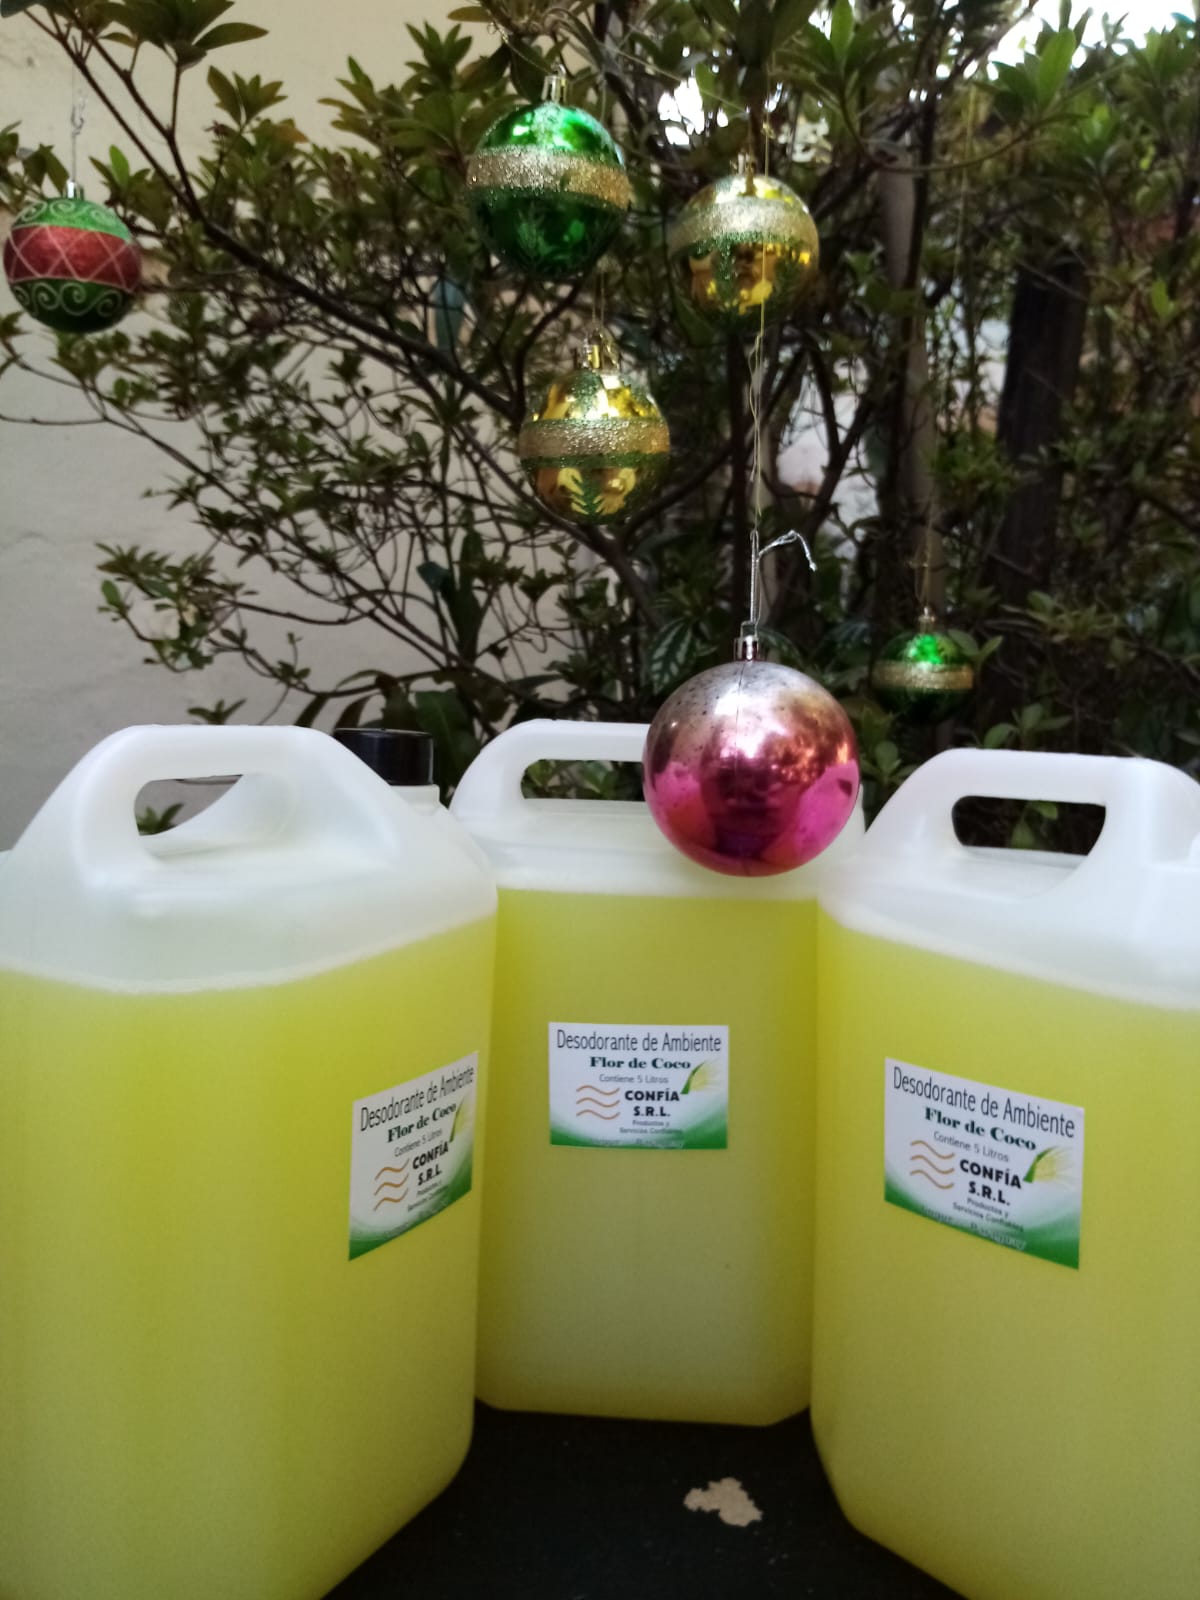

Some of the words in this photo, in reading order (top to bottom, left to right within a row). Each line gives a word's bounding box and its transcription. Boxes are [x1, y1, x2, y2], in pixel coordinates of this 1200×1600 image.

[557, 1029, 638, 1051] Desodorante
[642, 1033, 658, 1051] de
[662, 1033, 722, 1052] Ambiente
[589, 1056, 625, 1069] Flor
[628, 1057, 647, 1069] de
[651, 1057, 691, 1070] Coco
[599, 1074, 635, 1084] Contiene
[637, 1074, 642, 1084] 5
[645, 1074, 669, 1084] Litros
[360, 1091, 424, 1132] Desodorante
[426, 1080, 439, 1104] de
[439, 1066, 475, 1097] Ambiente
[624, 1086, 680, 1101] CONFÍA
[893, 1066, 977, 1112] Desodorante
[981, 1092, 999, 1118] de
[1003, 1098, 1075, 1138] Ambiente
[387, 1124, 415, 1143] Flor
[416, 1114, 430, 1130] de
[432, 1102, 457, 1121] Coco
[633, 1106, 671, 1117] S.R.L.
[925, 1107, 961, 1128] Flor
[964, 1120, 986, 1137] de
[990, 1126, 1037, 1151] Coco
[394, 1139, 421, 1157] Contiene
[422, 1136, 427, 1147] 5
[428, 1128, 443, 1144] Litros
[412, 1139, 450, 1170] CONFÍA
[933, 1131, 971, 1152] Contiene
[973, 1142, 980, 1154] 5
[982, 1146, 1009, 1163] Litros
[959, 1159, 1022, 1190] CONFÍA
[967, 1198, 1003, 1215] Productos
[968, 1182, 1011, 1206] S.R.L.
[953, 1202, 984, 1219] Servicios
